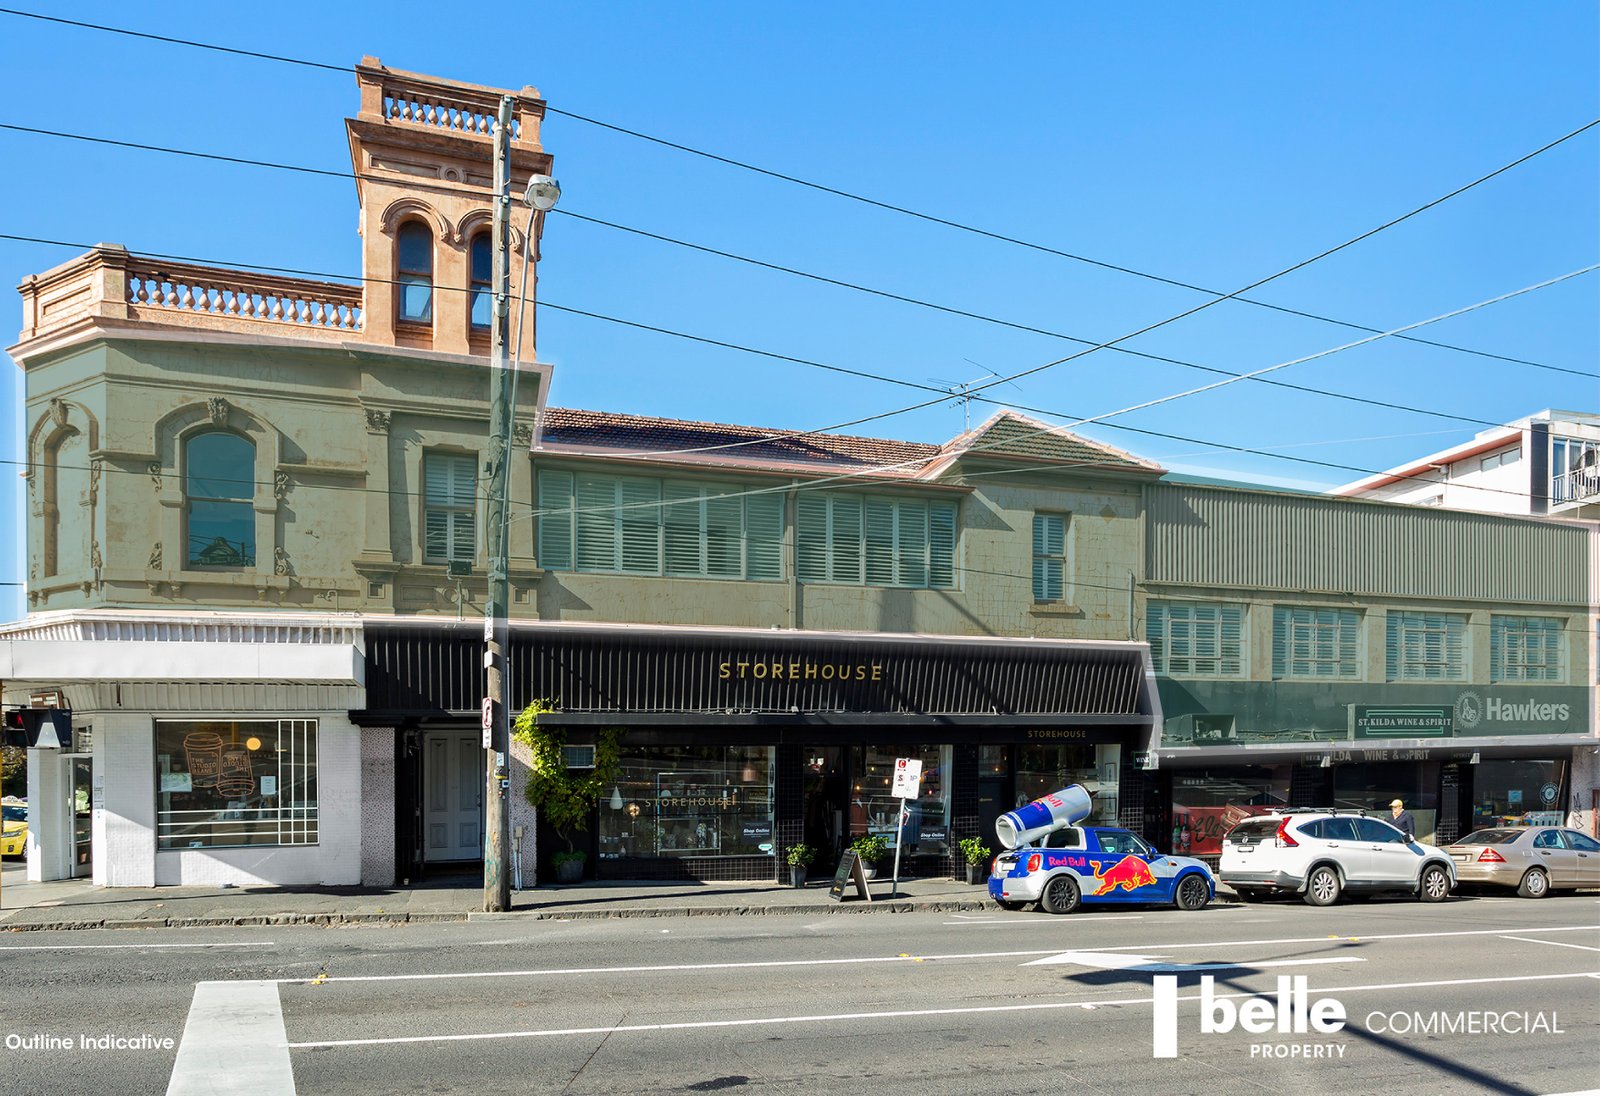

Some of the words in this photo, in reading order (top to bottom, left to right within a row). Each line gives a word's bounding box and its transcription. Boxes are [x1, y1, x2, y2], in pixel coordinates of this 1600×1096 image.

[719, 662, 882, 681] STOREHOUSE
[1486, 698, 1570, 721] Hawkers
[1027, 730, 1087, 738] STOREHOUSE
[1363, 750, 1388, 761] WINE
[1392, 750, 1400, 760] &
[645, 796, 732, 808] STOREHOUSE
[1048, 856, 1067, 867] Red
[1067, 857, 1086, 867] Bull
